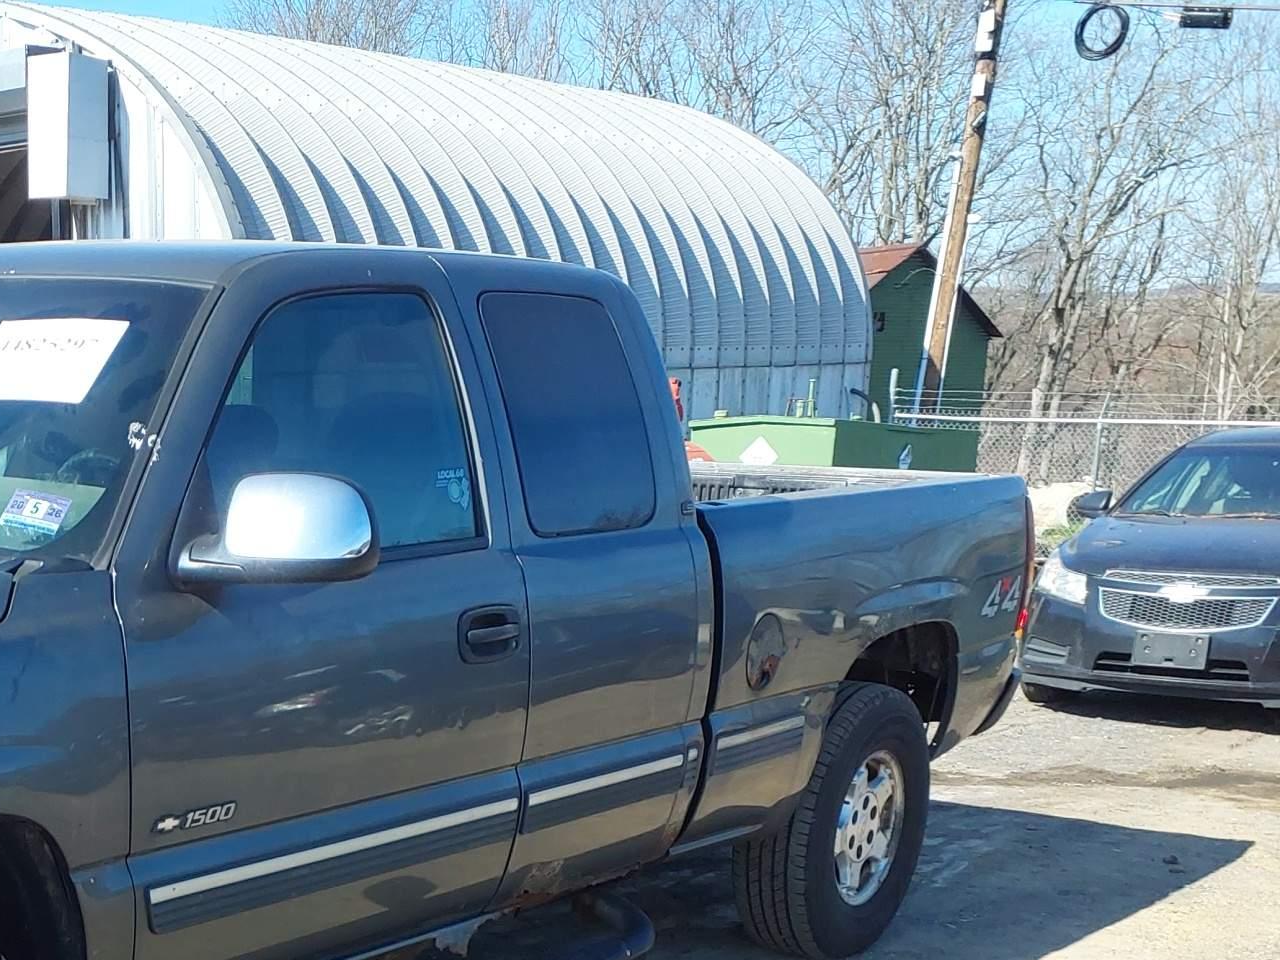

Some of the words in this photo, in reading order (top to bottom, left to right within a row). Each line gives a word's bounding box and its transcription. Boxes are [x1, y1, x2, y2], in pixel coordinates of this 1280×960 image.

[10, 499, 25, 510] 20
[30, 501, 42, 514] 5
[47, 507, 63, 518] 26
[185, 802, 236, 828] 1500
